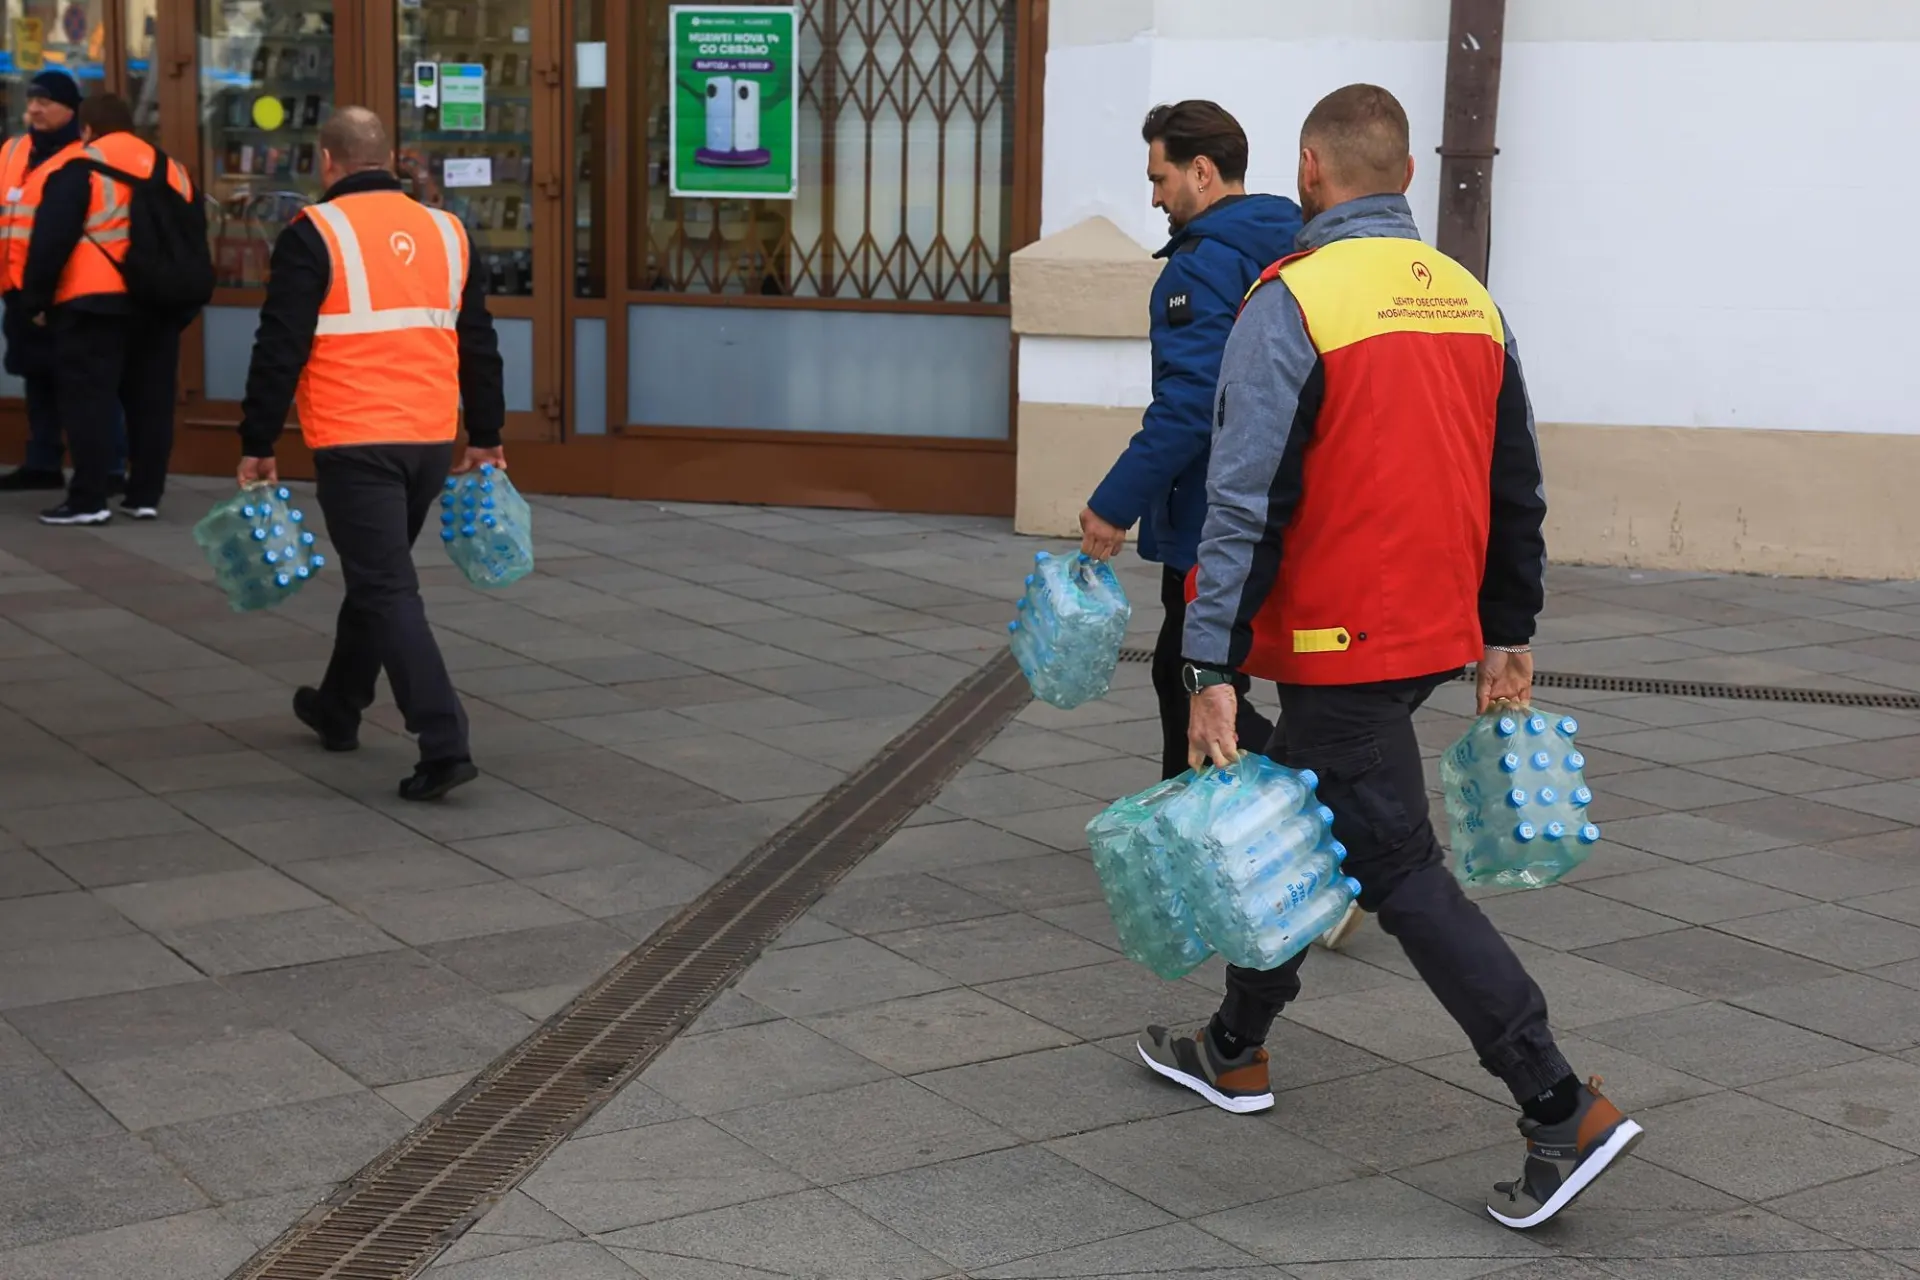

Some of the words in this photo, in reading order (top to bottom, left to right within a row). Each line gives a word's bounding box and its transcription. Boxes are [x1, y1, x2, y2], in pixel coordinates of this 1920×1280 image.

[699, 44, 717, 54] СО
[1169, 295, 1186, 308] HH
[1392, 297, 1414, 307] ЦЕНТР
[1415, 298, 1468, 307] ОБЕСПЕЧЕНИЯ
[1378, 309, 1434, 319] МОБИЛЬНОСТИ
[1436, 309, 1485, 319] ПАССАЖИРОВ
